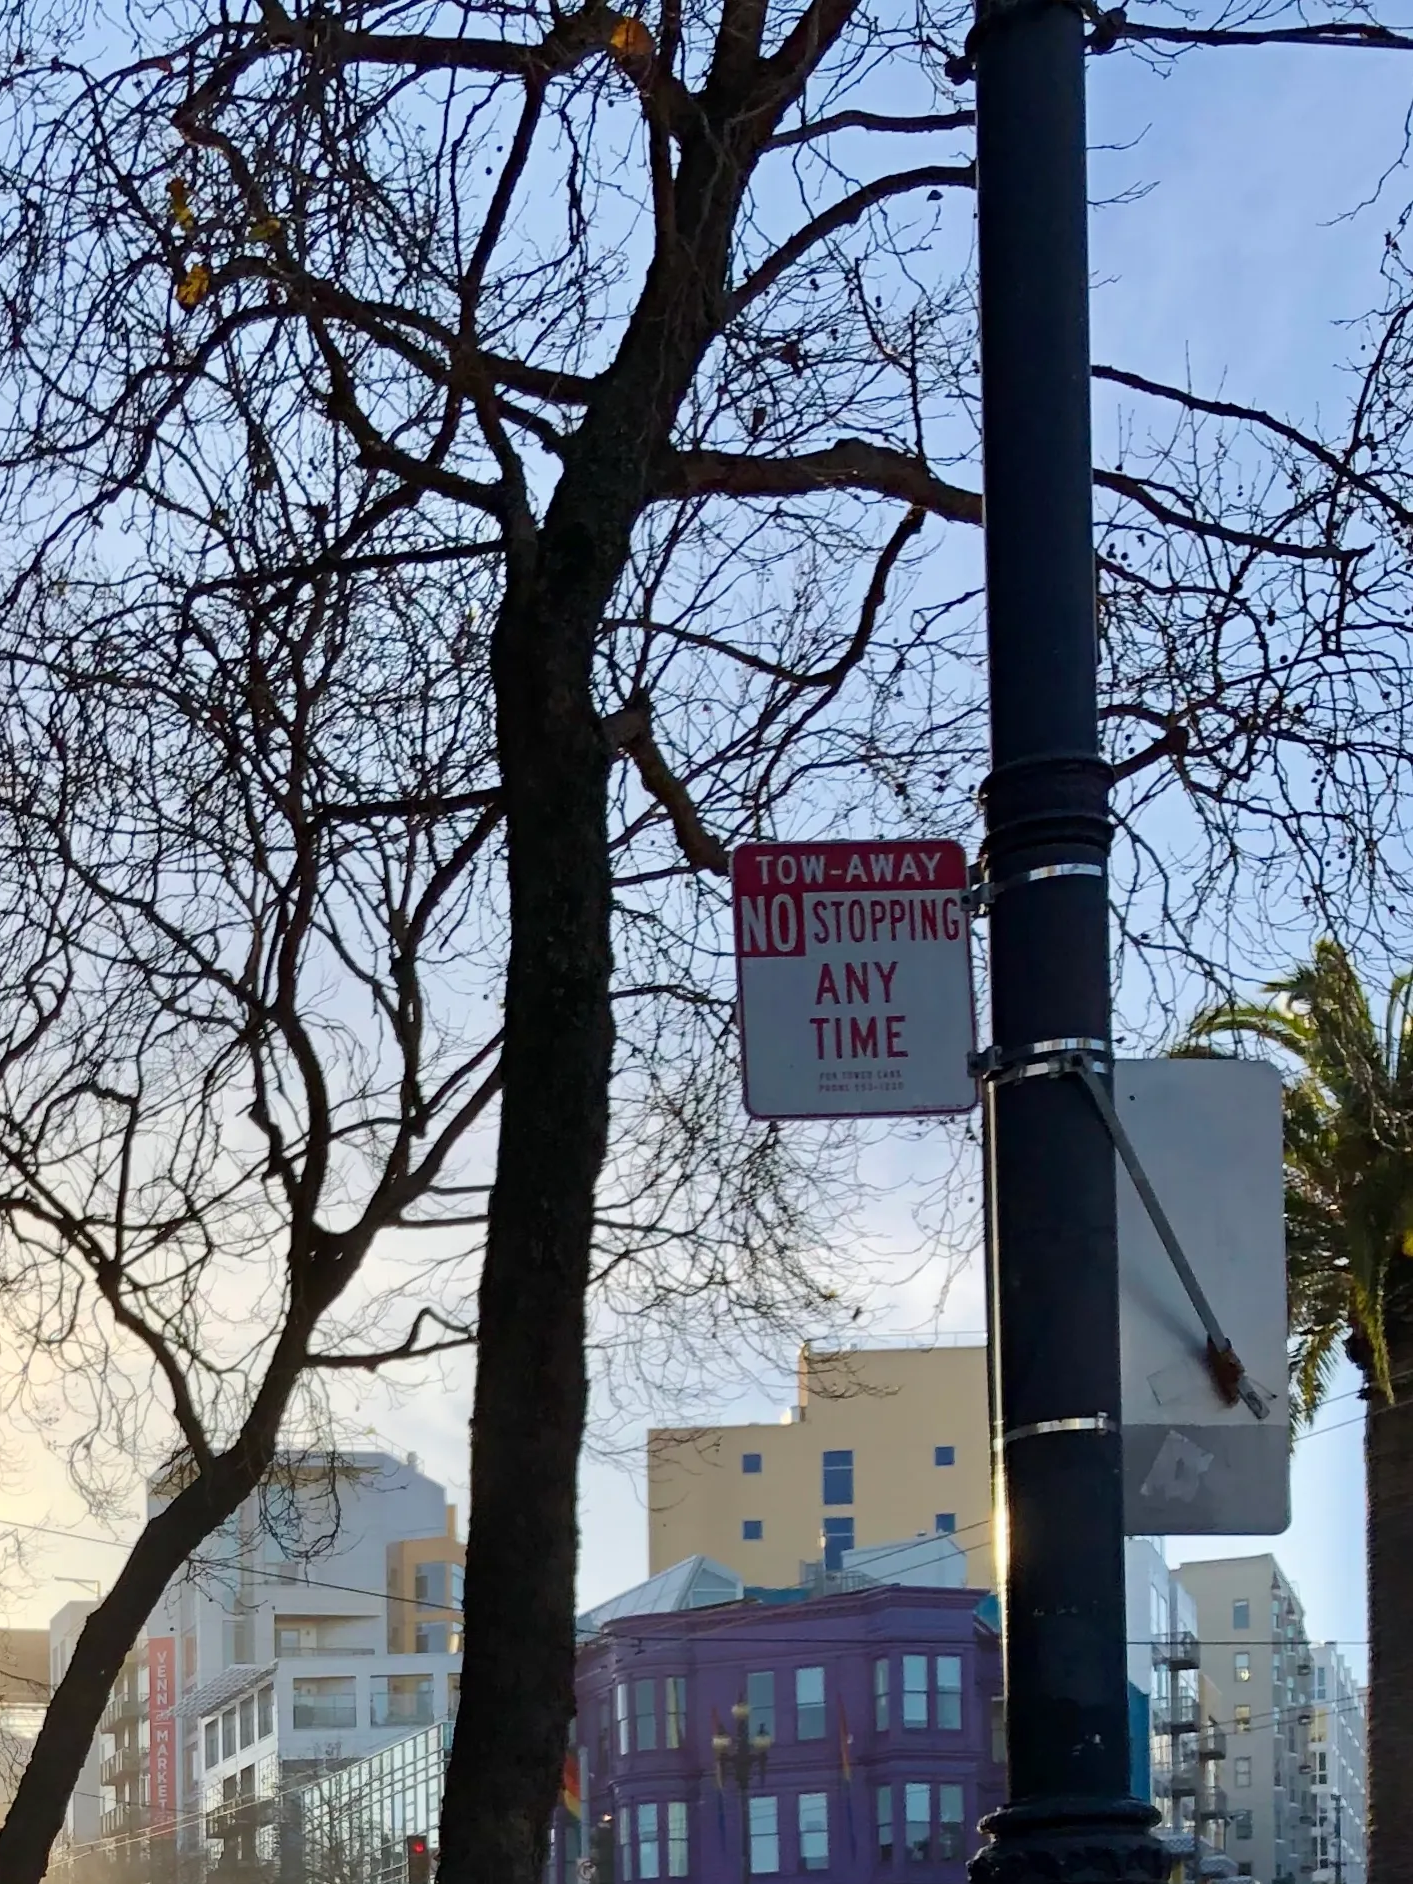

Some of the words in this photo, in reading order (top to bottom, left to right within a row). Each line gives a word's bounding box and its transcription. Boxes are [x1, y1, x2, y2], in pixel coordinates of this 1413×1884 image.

[755, 852, 943, 885] TOW-AWAY
[741, 893, 799, 953] NO
[812, 897, 961, 944] STOPPING
[814, 960, 900, 1005] ANY
[809, 1015, 909, 1060] TIME
[156, 1651, 169, 1705] VENN
[156, 1730, 169, 1811] MARKET
